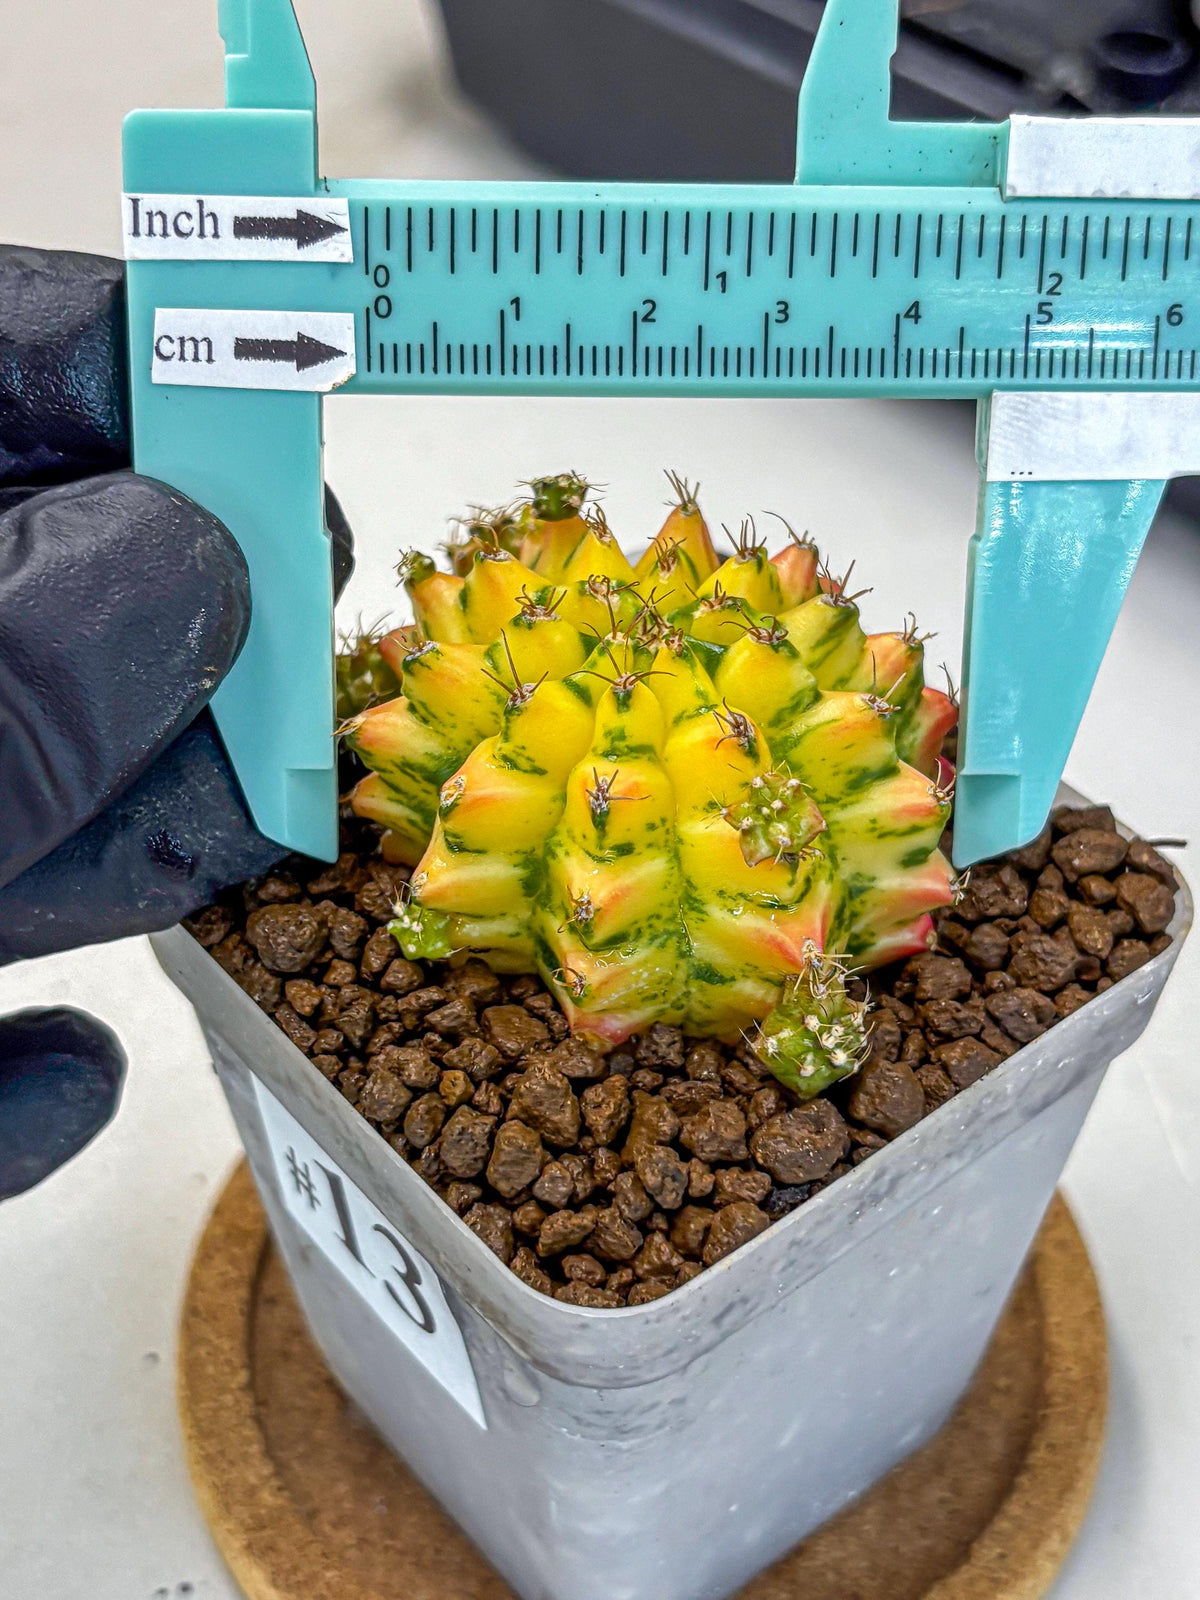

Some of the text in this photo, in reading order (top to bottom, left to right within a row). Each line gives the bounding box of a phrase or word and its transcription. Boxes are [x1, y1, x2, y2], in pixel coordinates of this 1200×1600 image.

[127, 197, 220, 239] Inch
[373, 264, 1063, 297] 0 1 2
[373, 294, 1184, 327] 0 1 2 3 4 5 6
[154, 334, 216, 365] cm
[285, 1145, 437, 1335] #13
